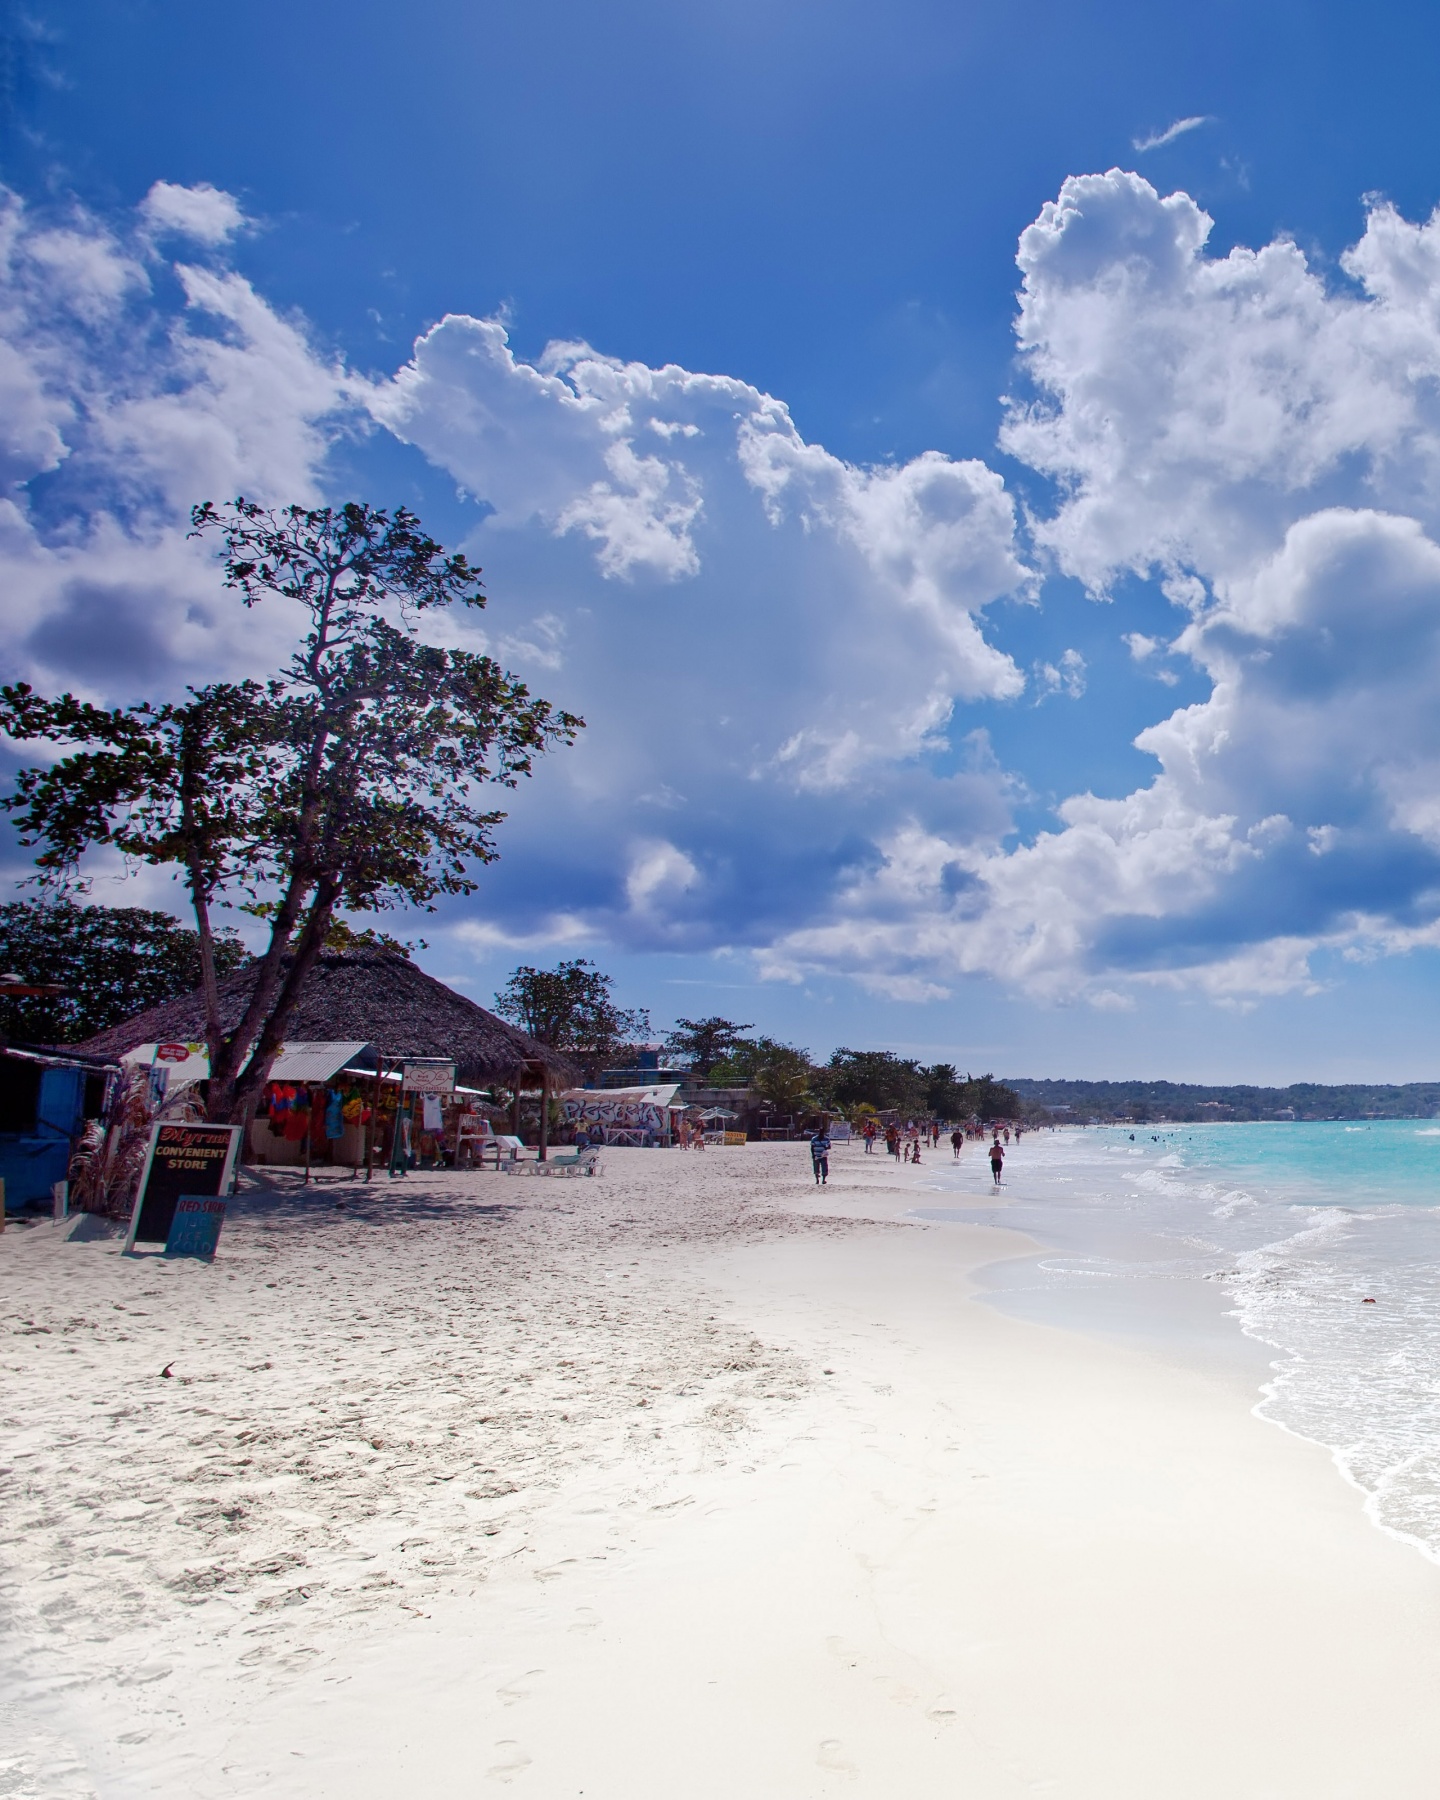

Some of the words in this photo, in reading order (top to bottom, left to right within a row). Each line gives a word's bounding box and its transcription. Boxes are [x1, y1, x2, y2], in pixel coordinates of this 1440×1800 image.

[155, 1146, 227, 1158] CONVENIENT
[168, 1159, 208, 1169] STORE
[178, 1200, 201, 1213] RED
[172, 1240, 211, 1253] COLD
